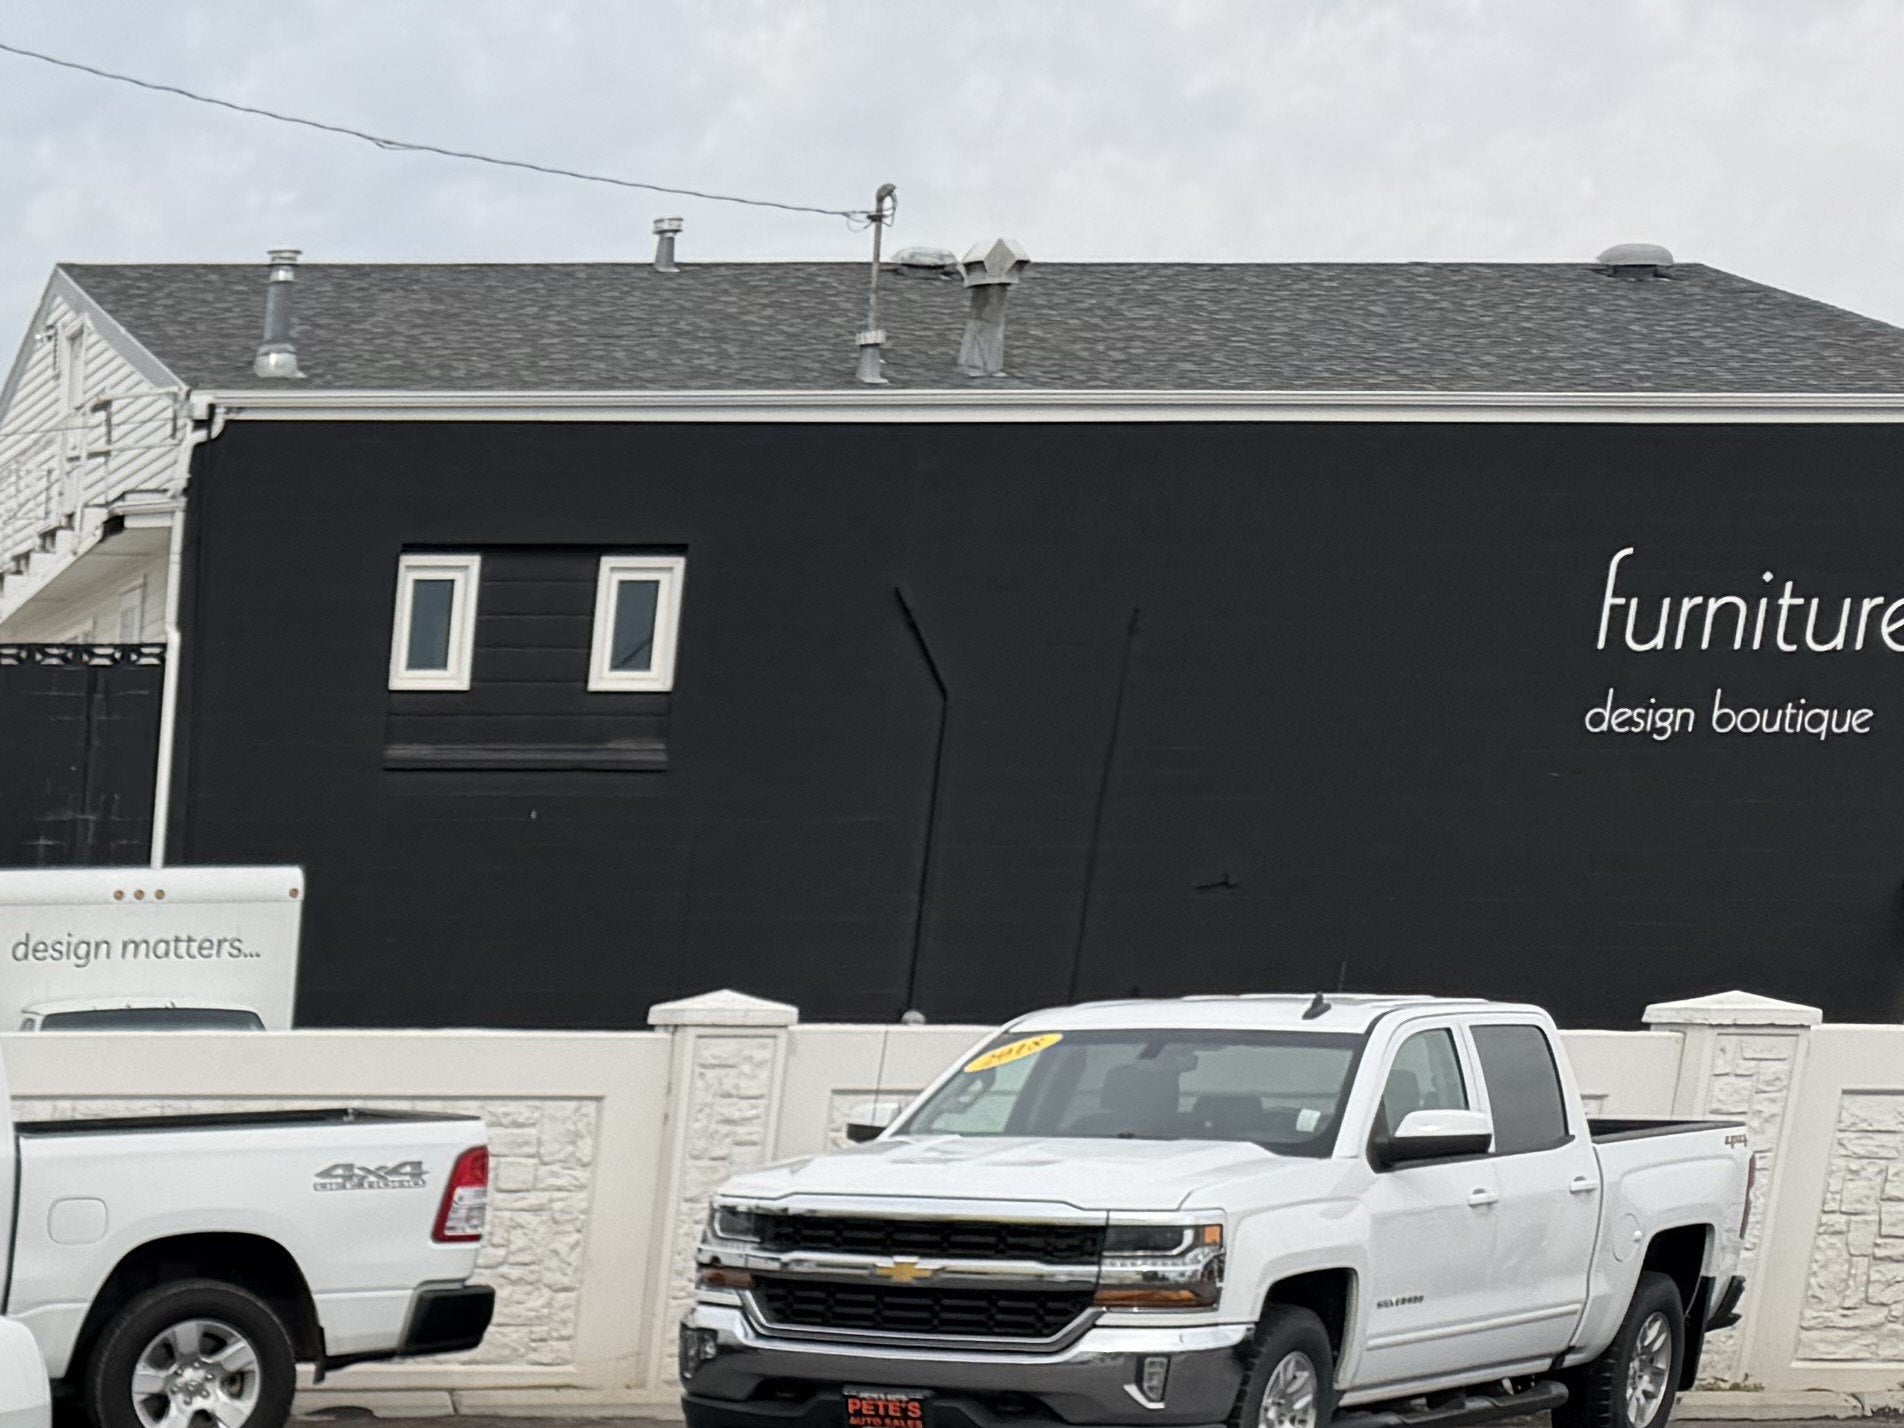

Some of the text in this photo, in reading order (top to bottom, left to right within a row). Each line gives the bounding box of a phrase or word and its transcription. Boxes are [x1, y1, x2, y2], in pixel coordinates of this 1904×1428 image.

[1584, 687, 1875, 741] design boutique
[11, 932, 262, 969] design matters...
[848, 1398, 922, 1418] PETE'S
[849, 1416, 882, 1426] AUTO
